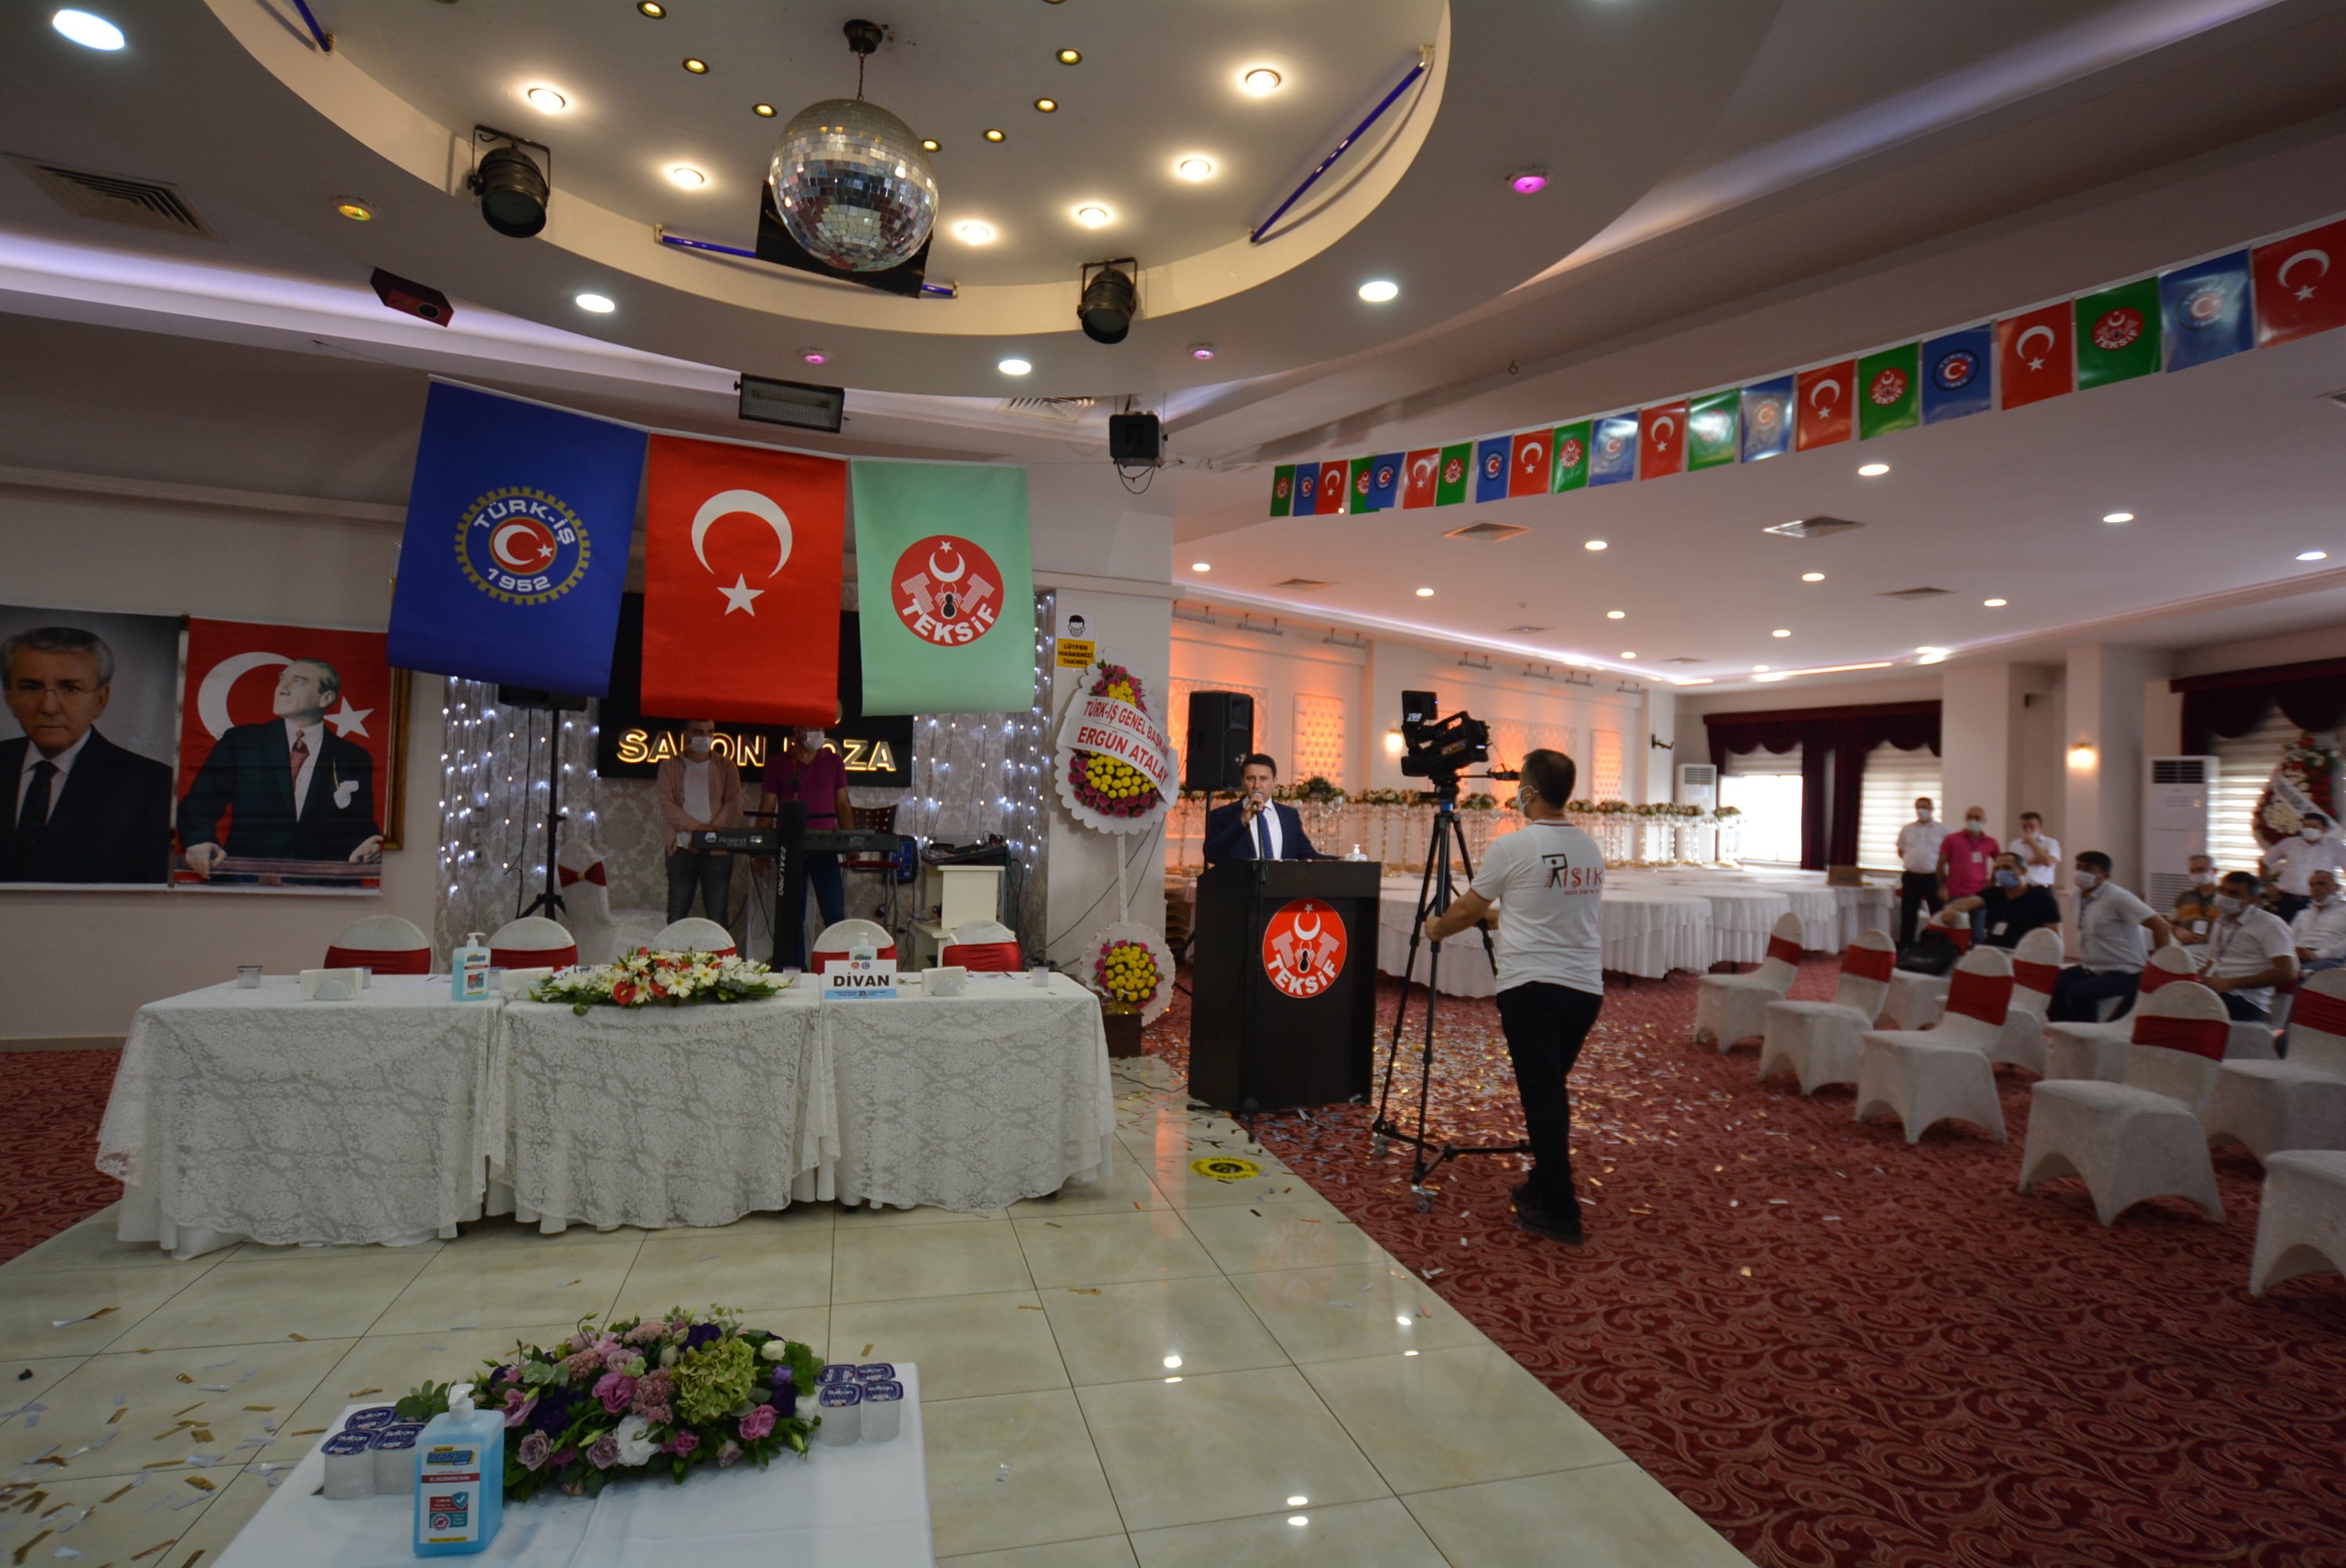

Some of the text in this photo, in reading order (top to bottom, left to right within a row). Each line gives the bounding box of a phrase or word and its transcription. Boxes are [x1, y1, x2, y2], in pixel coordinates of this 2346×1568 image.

[473, 499, 576, 546] TÜRK-İŞ
[487, 568, 551, 593] 1952
[1063, 642, 1088, 651] LÜTFEN
[1118, 707, 1146, 735] GENEL
[1077, 725, 1169, 786] ERGÜN ATALAY
[833, 971, 890, 987] DİVAN
